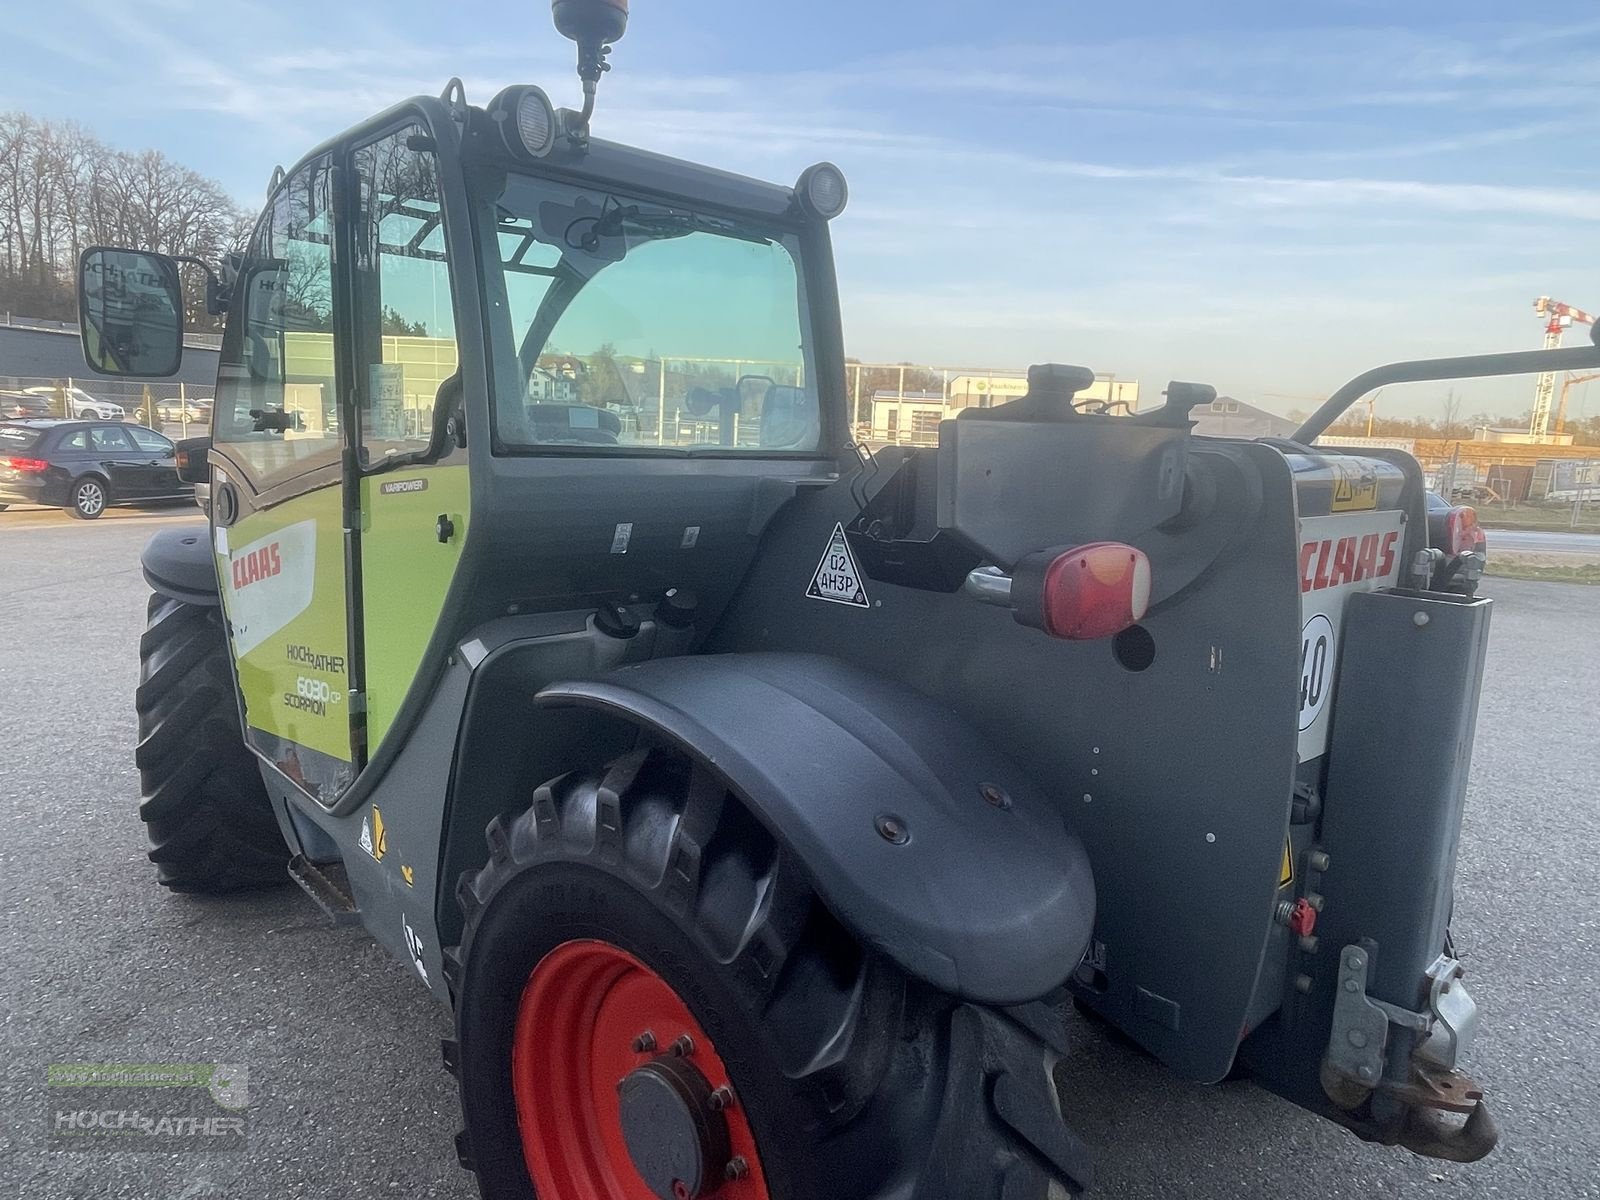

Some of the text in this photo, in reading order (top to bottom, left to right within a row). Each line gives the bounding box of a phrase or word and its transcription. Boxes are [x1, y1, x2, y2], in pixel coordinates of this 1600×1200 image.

[232, 542, 281, 590] CLAAS
[1301, 531, 1399, 593] CLAAS
[821, 573, 853, 593] AH3P
[287, 644, 345, 674] HOCHRATHER
[297, 676, 329, 703] 6030
[284, 692, 326, 717] SCORPION
